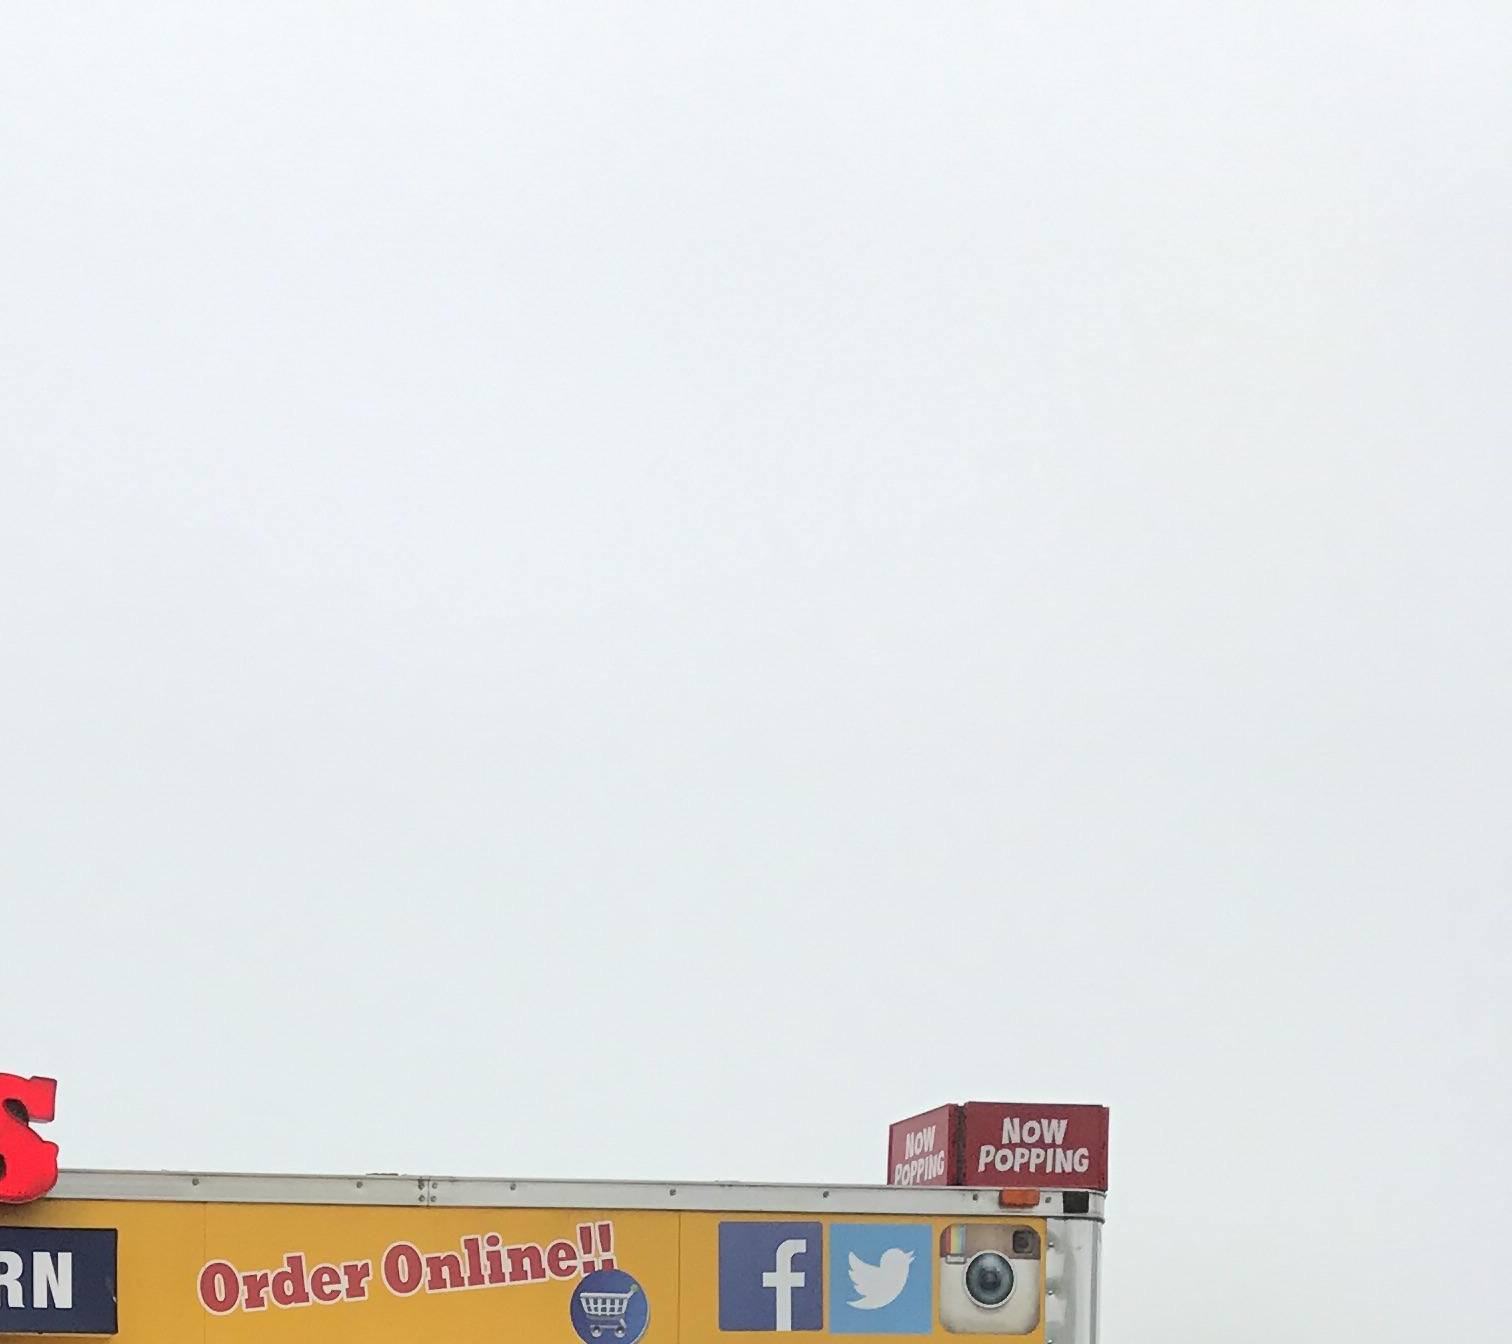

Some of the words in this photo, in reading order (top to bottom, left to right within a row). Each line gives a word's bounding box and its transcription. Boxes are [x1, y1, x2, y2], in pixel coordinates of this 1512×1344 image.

[905, 1125, 936, 1160] NOW
[1001, 1117, 1068, 1146] NOW
[894, 1150, 945, 1185] POPPING
[978, 1145, 1089, 1174] POPPING
[199, 1253, 371, 1314] Order
[383, 1222, 616, 1297] Online!!
